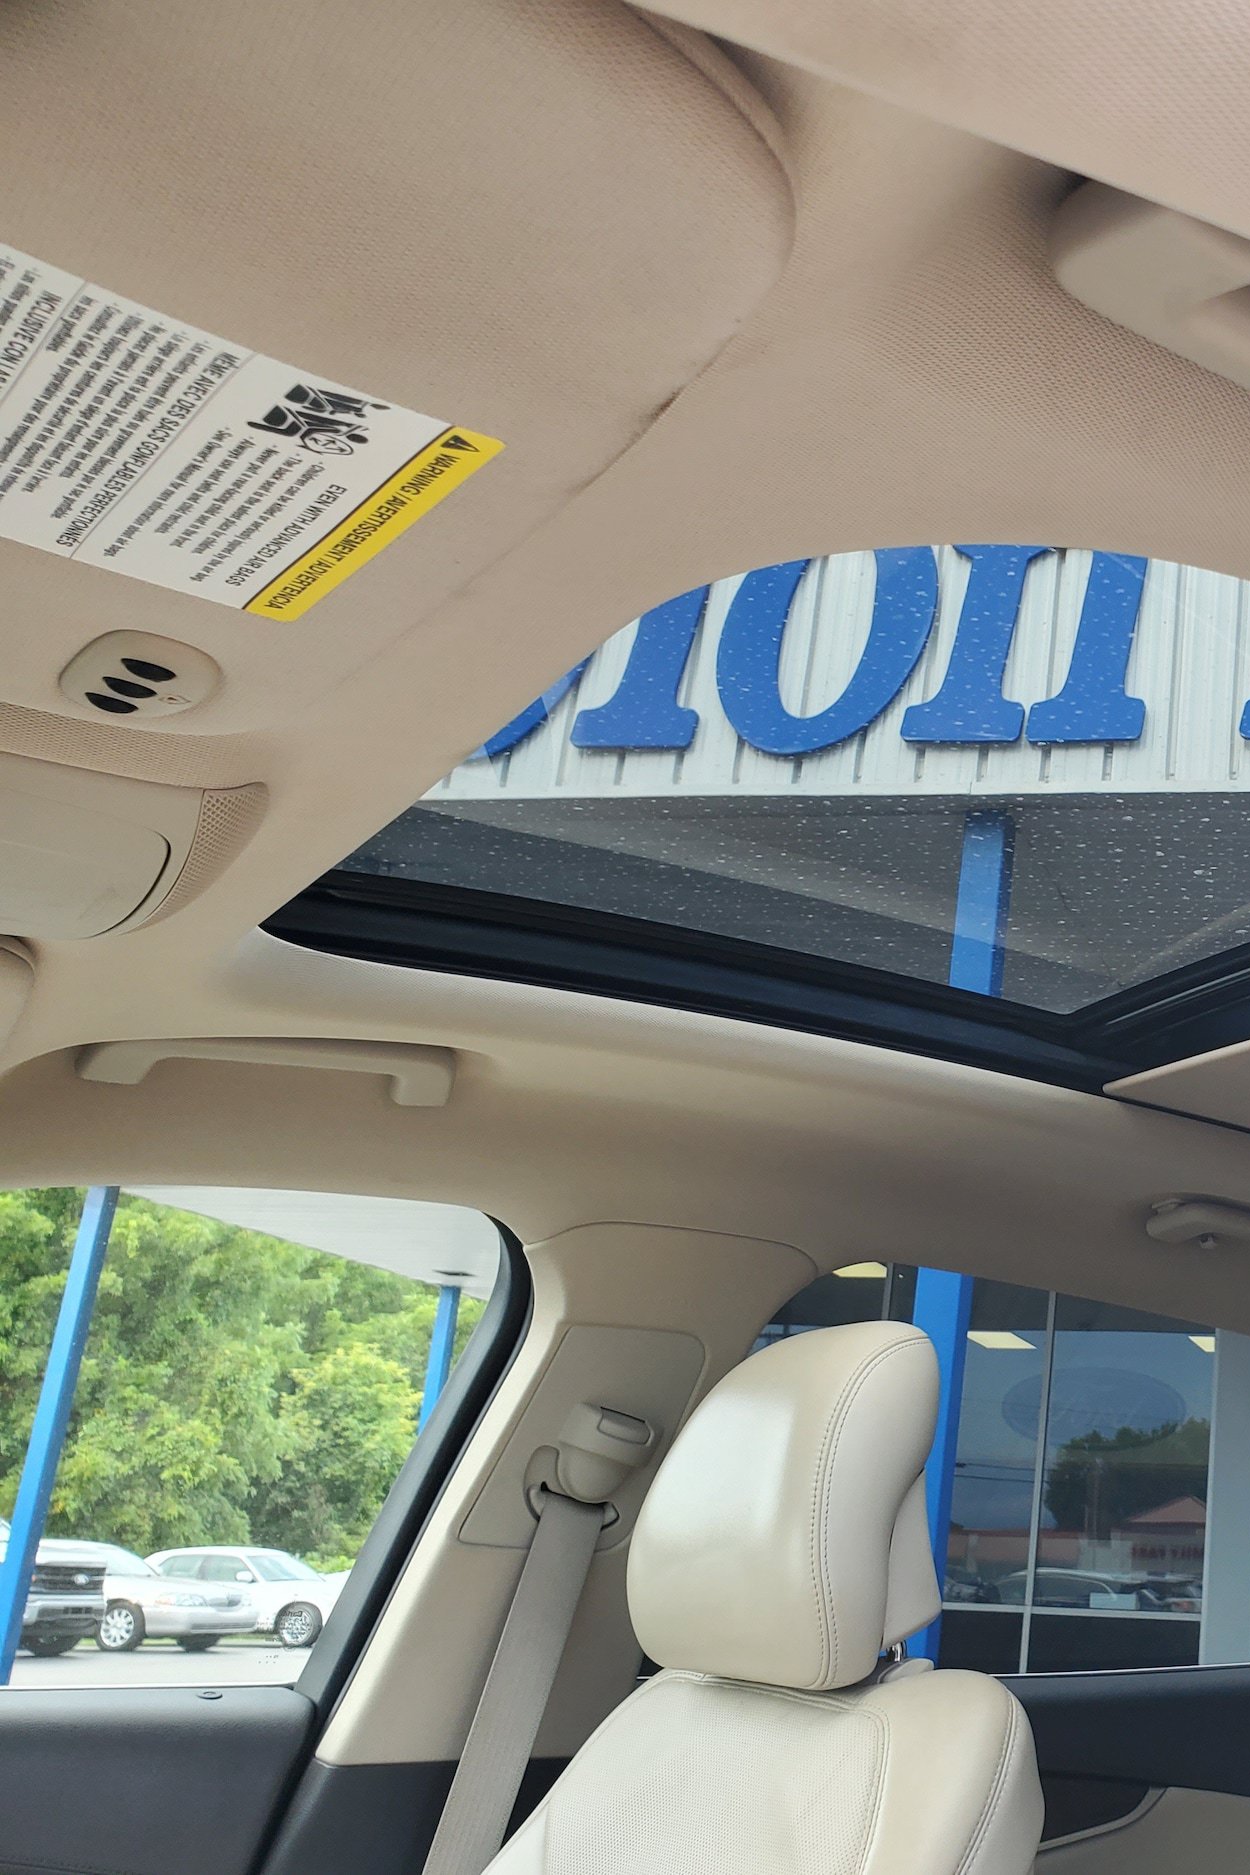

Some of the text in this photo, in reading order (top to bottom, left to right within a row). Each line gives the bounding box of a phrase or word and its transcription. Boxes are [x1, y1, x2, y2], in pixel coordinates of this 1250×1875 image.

[12, 290, 63, 345] INCLUSIVE
[0, 340, 29, 366] CON
[182, 374, 217, 402] AVEC
[166, 397, 198, 420] DES
[146, 416, 181, 443] SACS
[211, 429, 234, 443] See
[226, 438, 257, 460] Always
[255, 447, 281, 465] Never
[103, 440, 161, 492] GONFLABLES
[217, 458, 236, 470] use
[244, 461, 263, 476] put
[281, 456, 304, 468] The
[175, 462, 204, 484] Manual
[206, 468, 227, 483] seat
[269, 466, 294, 481] back
[293, 464, 326, 488] Children
[399, 453, 461, 496] WARNING
[168, 480, 187, 491] for
[194, 479, 219, 494] belts
[257, 479, 277, 494] seat
[283, 485, 302, 497] can
[156, 488, 177, 503] more
[185, 492, 204, 505] and
[243, 496, 263, 507] the
[252, 490, 269, 498] is
[276, 494, 295, 504] be
[132, 500, 169, 527] information
[173, 500, 195, 516] child
[203, 502, 225, 518] child
[228, 504, 253, 521] safest
[262, 501, 288, 518] killed
[55, 488, 119, 548] PERFECTIONNÉS
[193, 513, 213, 527] seat
[216, 517, 238, 532] place
[257, 514, 271, 523] or
[119, 524, 142, 540] about
[180, 528, 199, 538] the
[209, 529, 228, 539] for
[224, 483, 348, 587] EVEN WITH ADVANCED AIR BAGS
[233, 520, 265, 541] seriously
[114, 537, 129, 546] air
[206, 558, 224, 568] the
[212, 552, 231, 561] by
[200, 565, 215, 574] air
